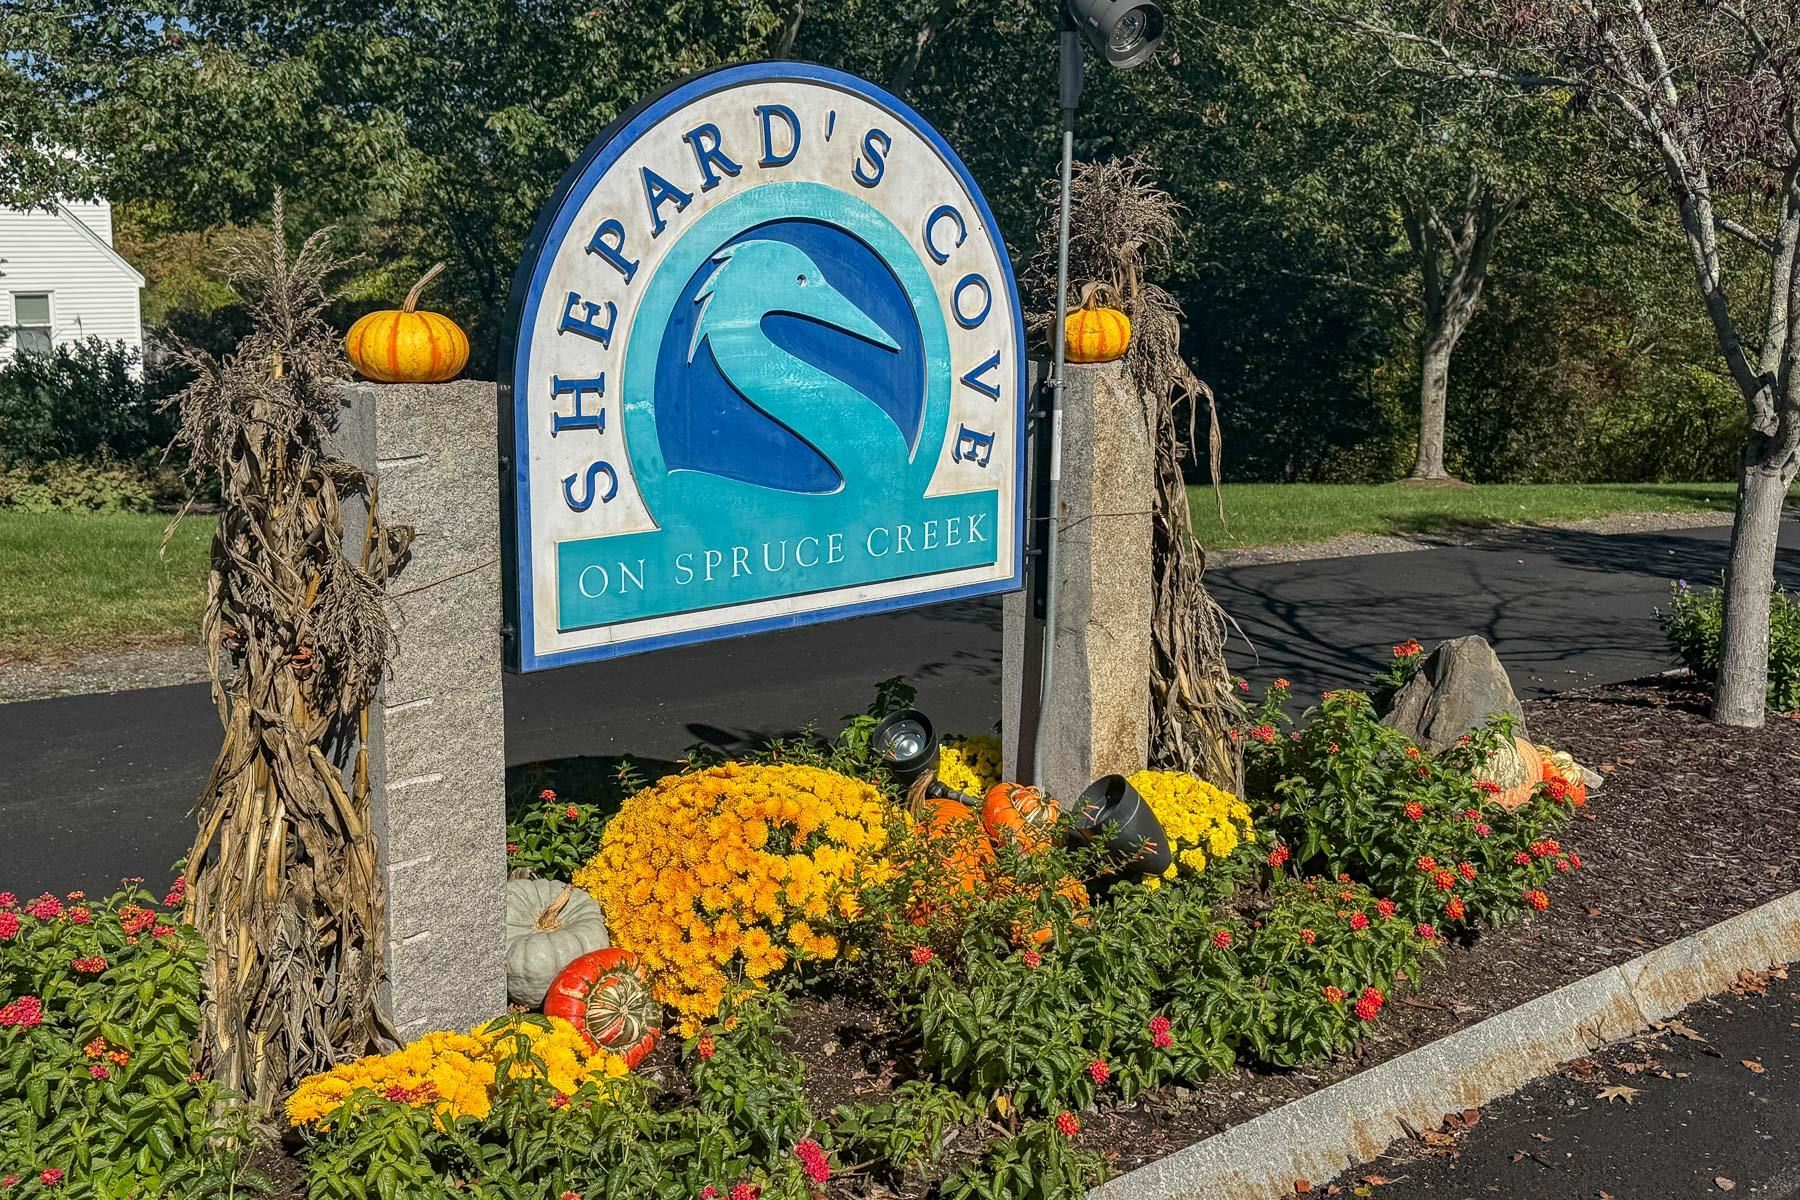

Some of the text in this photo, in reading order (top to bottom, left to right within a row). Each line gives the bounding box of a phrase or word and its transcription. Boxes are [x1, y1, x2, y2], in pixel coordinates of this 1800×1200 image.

[551, 104, 1000, 512] SHEPARD'S COVE
[579, 513, 988, 600] ON SPRUCE CREEK
